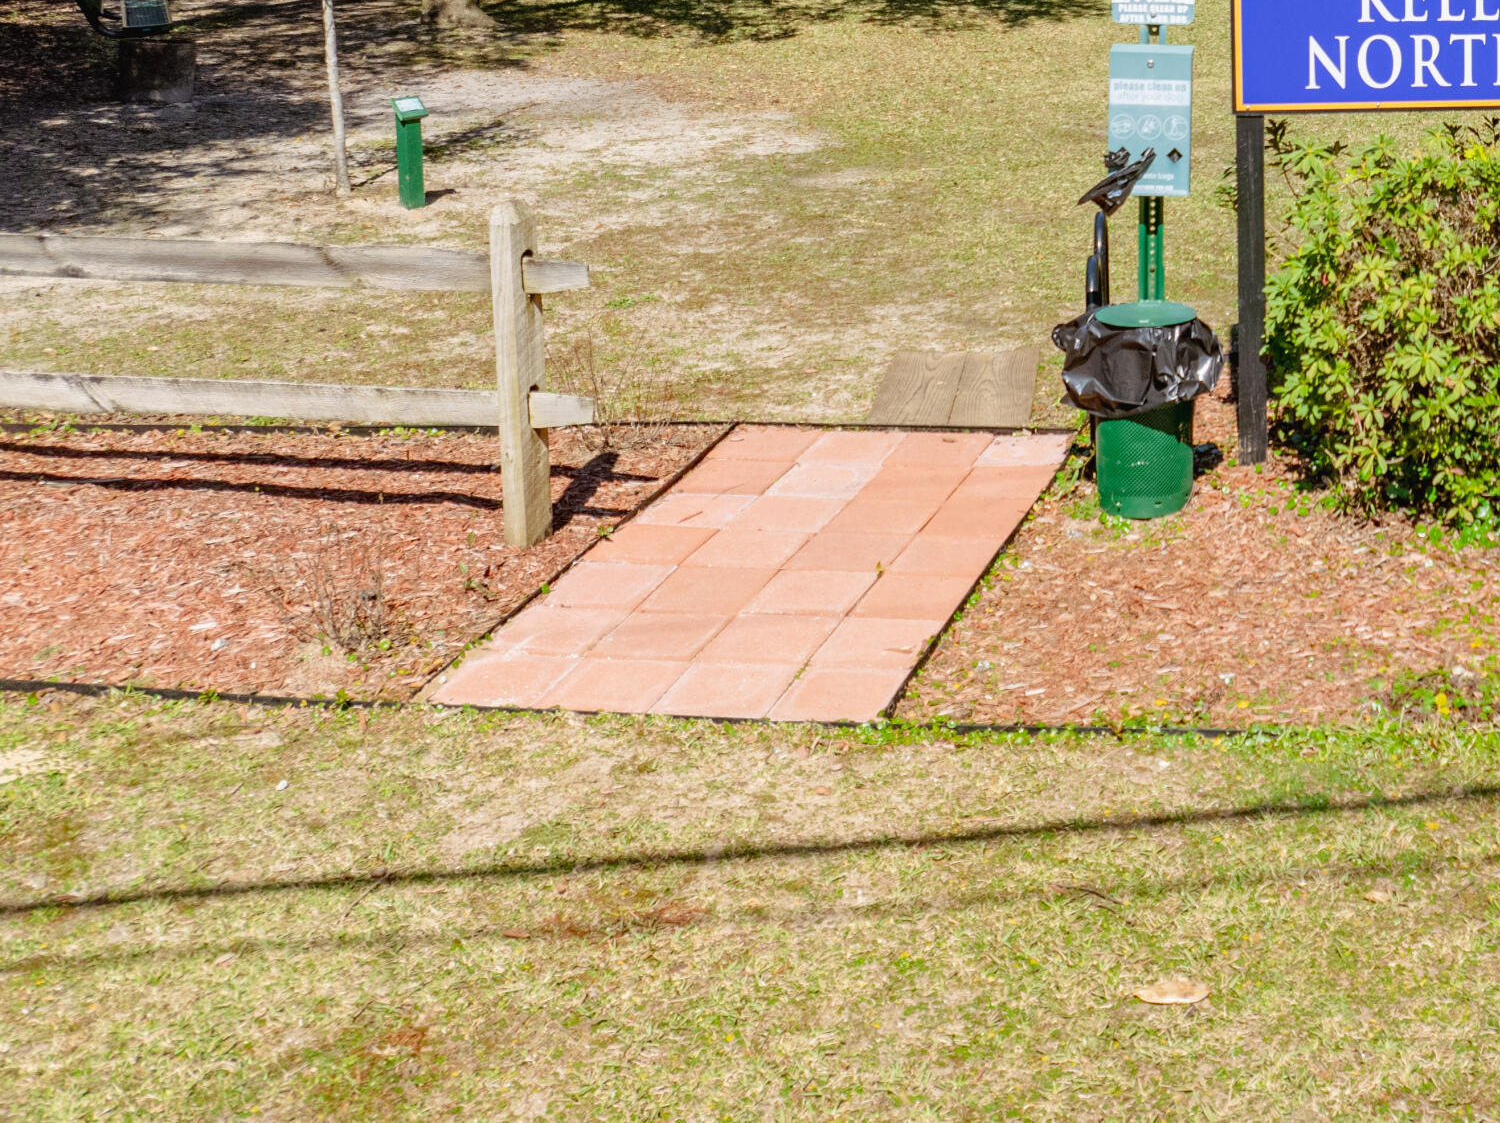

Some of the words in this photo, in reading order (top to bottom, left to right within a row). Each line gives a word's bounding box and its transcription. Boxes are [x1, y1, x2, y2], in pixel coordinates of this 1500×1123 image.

[1118, 3, 1148, 13] PLEASE
[1149, 4, 1176, 14] CLEAN
[1176, 5, 1189, 14] UP
